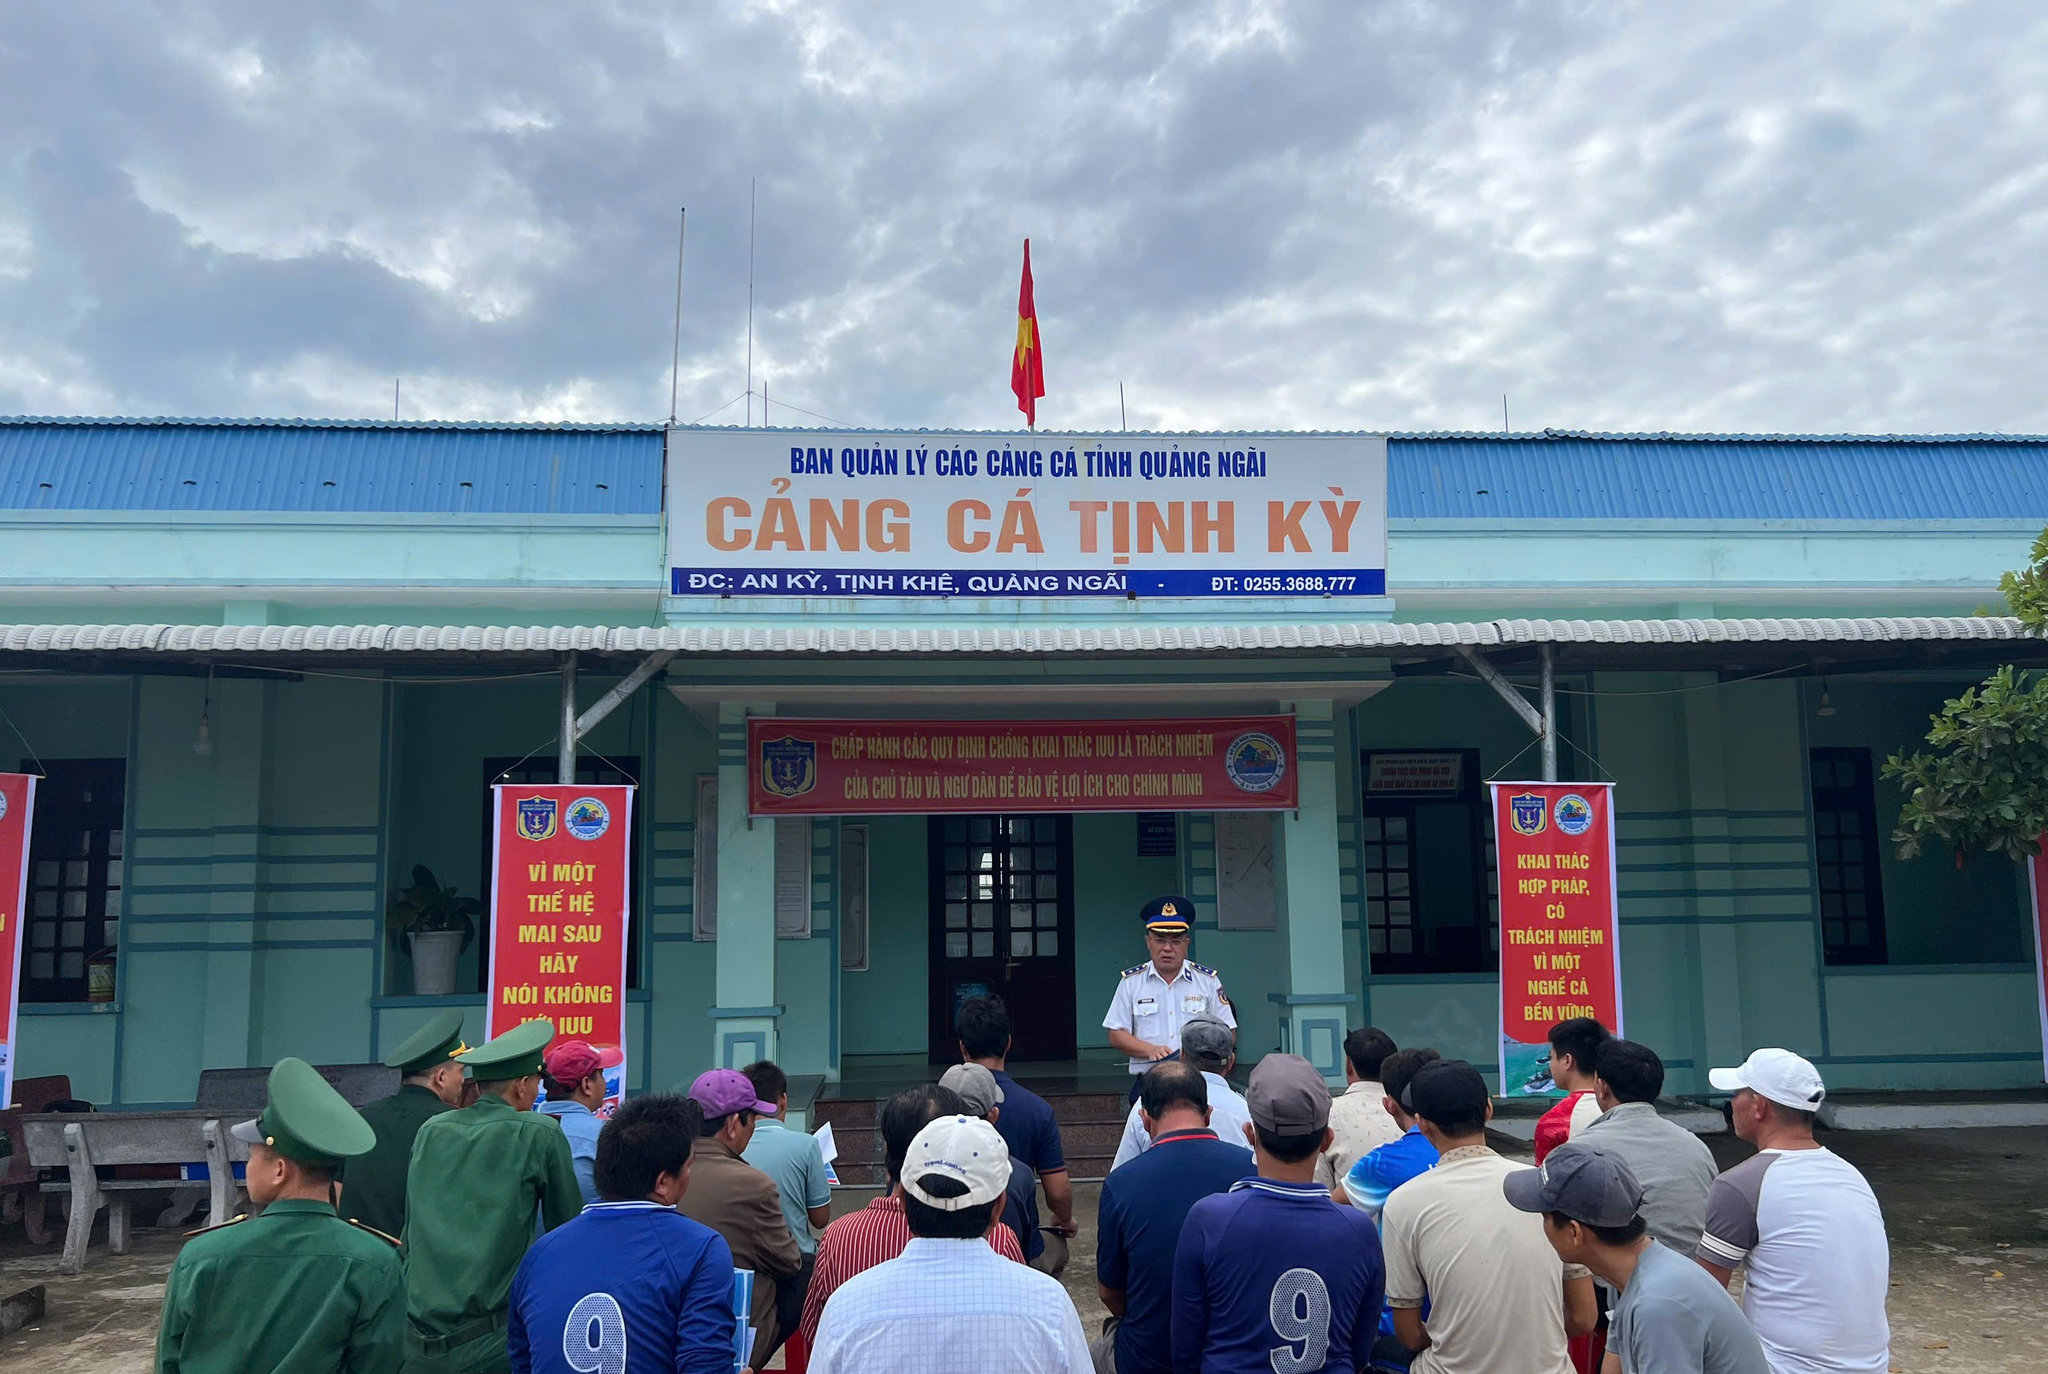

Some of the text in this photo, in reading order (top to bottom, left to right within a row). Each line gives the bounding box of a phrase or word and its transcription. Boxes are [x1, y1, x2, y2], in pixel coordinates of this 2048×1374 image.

[790, 442, 1267, 480] BAN QUẢN LÝ CÁC CẢNG CÁ TỈNH QUẢNG NGÃI
[706, 477, 1362, 565] CẢNG CÁ TỊNH KỲ
[688, 573, 734, 589] ĐC:
[741, 574, 778, 589] AN
[786, 570, 828, 591] KỲ,
[836, 574, 894, 593] TỊNH
[902, 573, 960, 594] KHÊ,
[968, 573, 1059, 592] QUẢNG
[1067, 573, 1127, 591] NGÃI
[1211, 576, 1239, 592] ĐT:
[1243, 576, 1357, 592] 0255.3688.777
[831, 728, 864, 760] CHẤP
[867, 732, 900, 760] HÀNH
[903, 731, 928, 759] CÁC
[931, 736, 953, 761] QUY
[957, 735, 986, 764] ĐỊNH
[988, 728, 1029, 759] CHỐNG
[1032, 735, 1060, 758] KHAI
[1062, 731, 1093, 758] THÁC
[1095, 735, 1115, 757] IUU
[1118, 730, 1133, 757] LÀ
[1135, 730, 1173, 757] TRÁCH
[1175, 729, 1214, 761] NHIỆM
[844, 766, 1203, 802] CỦA CHỦ TÀU VÀ NGƯ DÂN ĐỂ BẢO VỆ LỢI ÍCH CHO CHÍNH MÌNH
[1517, 851, 1590, 870] KHAI THÁC
[528, 860, 597, 886] VÌ MỘT
[1518, 876, 1590, 897] HỢP PHÁP,
[527, 889, 595, 916] THẾ HỆ
[1546, 901, 1566, 919] CÓ
[518, 924, 602, 943] MAI SAU
[1508, 926, 1604, 948] TRÁCH NHIỆM
[538, 951, 579, 974] HÃY
[1533, 951, 1581, 973] VÌ MỘT
[502, 982, 613, 1005] NÓI KHÔNG
[1527, 975, 1589, 995] NGHỀ CÁ
[1524, 1000, 1595, 1021] BỀN VỮNG
[559, 1016, 593, 1035] IUU
[1269, 1267, 1332, 1374] 9
[563, 1292, 628, 1374] 9
